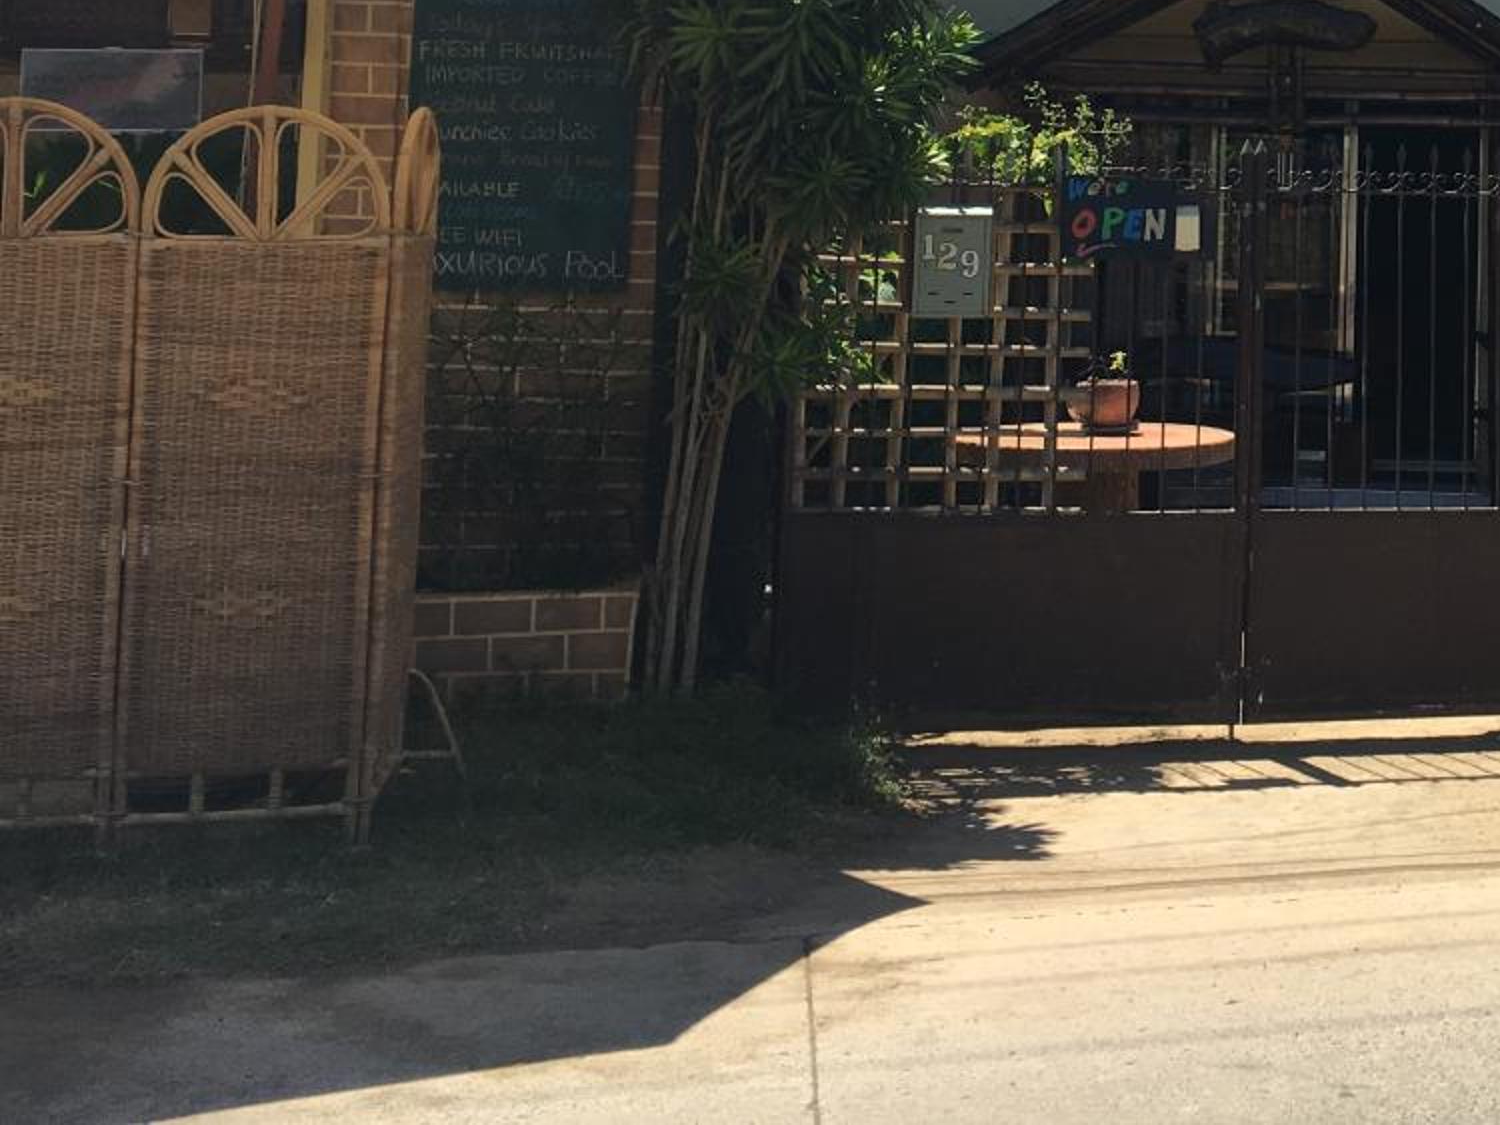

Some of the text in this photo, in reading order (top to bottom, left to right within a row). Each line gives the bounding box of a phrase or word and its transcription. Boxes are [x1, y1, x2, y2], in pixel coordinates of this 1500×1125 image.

[418, 40, 486, 61] FRESH
[438, 181, 521, 198] AILABLE
[1071, 207, 1167, 242] OPEN
[921, 234, 980, 278] 129
